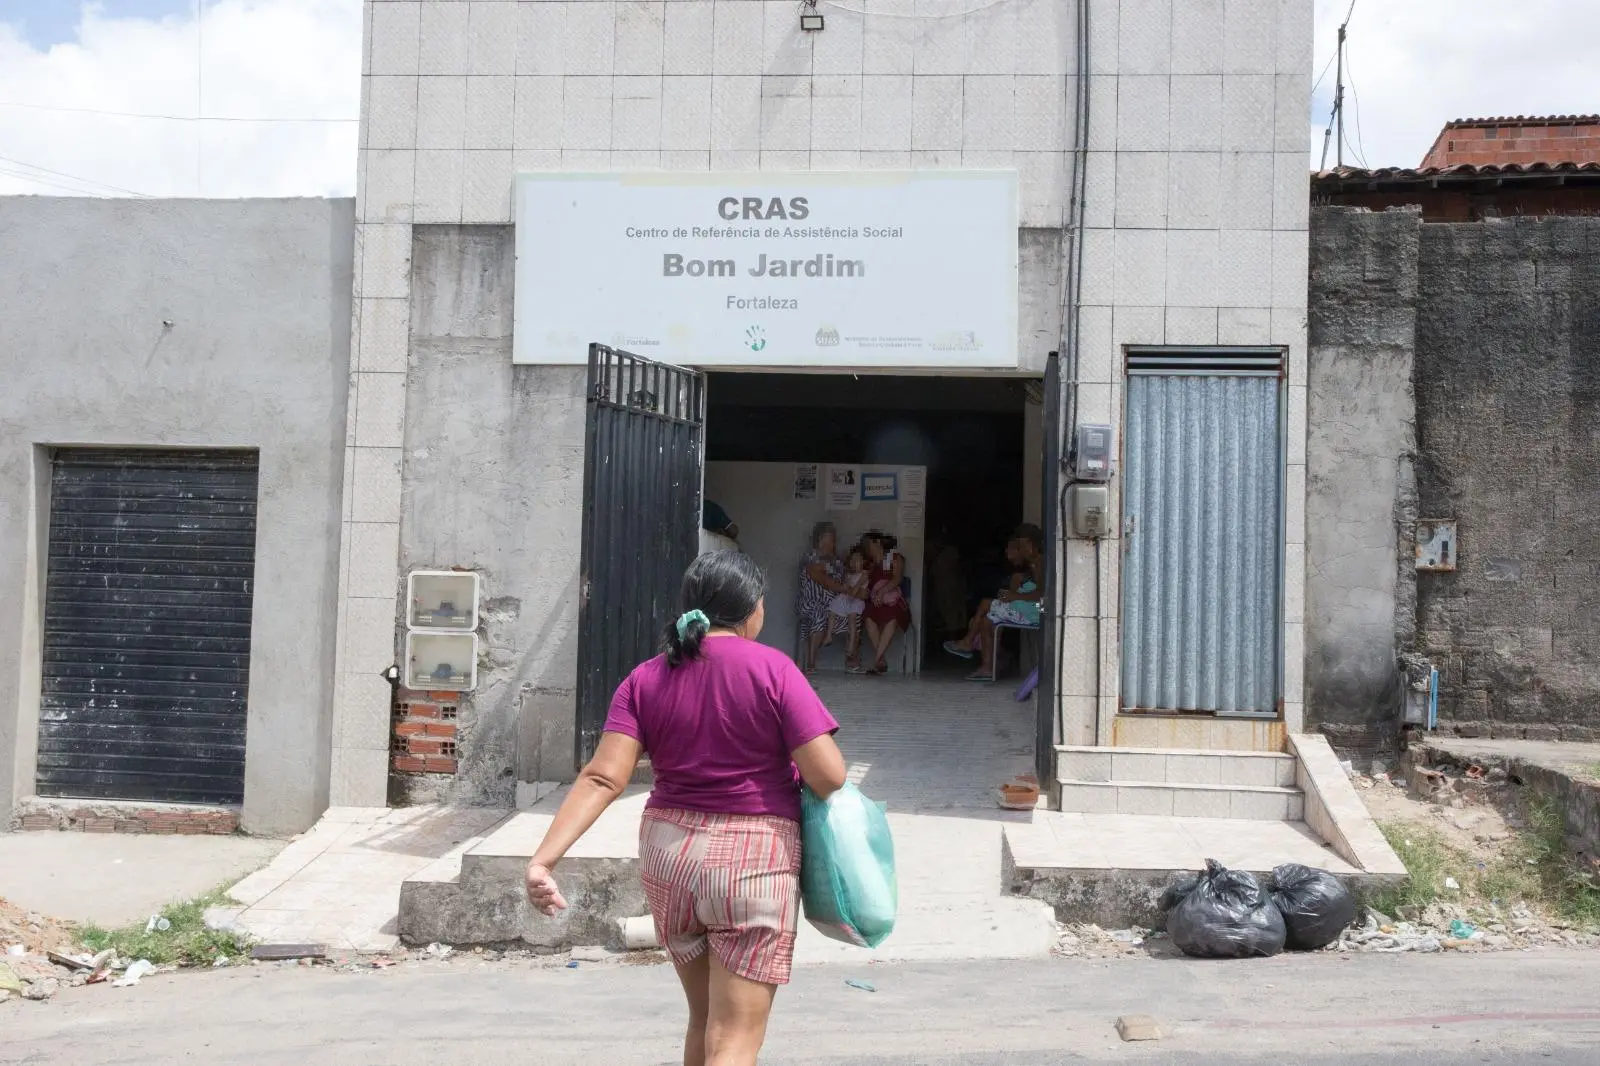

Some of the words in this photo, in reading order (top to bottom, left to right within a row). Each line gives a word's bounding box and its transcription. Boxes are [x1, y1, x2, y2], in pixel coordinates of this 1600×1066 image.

[718, 196, 809, 220] CRAS
[625, 227, 668, 238] Centro
[672, 227, 688, 238] de
[691, 226, 760, 238] Referência
[764, 227, 780, 238] de
[783, 226, 858, 238] Assistência
[862, 226, 903, 238] Social
[662, 253, 736, 277] Bom
[747, 253, 865, 277] Jardim
[726, 295, 798, 310] Fortaleza
